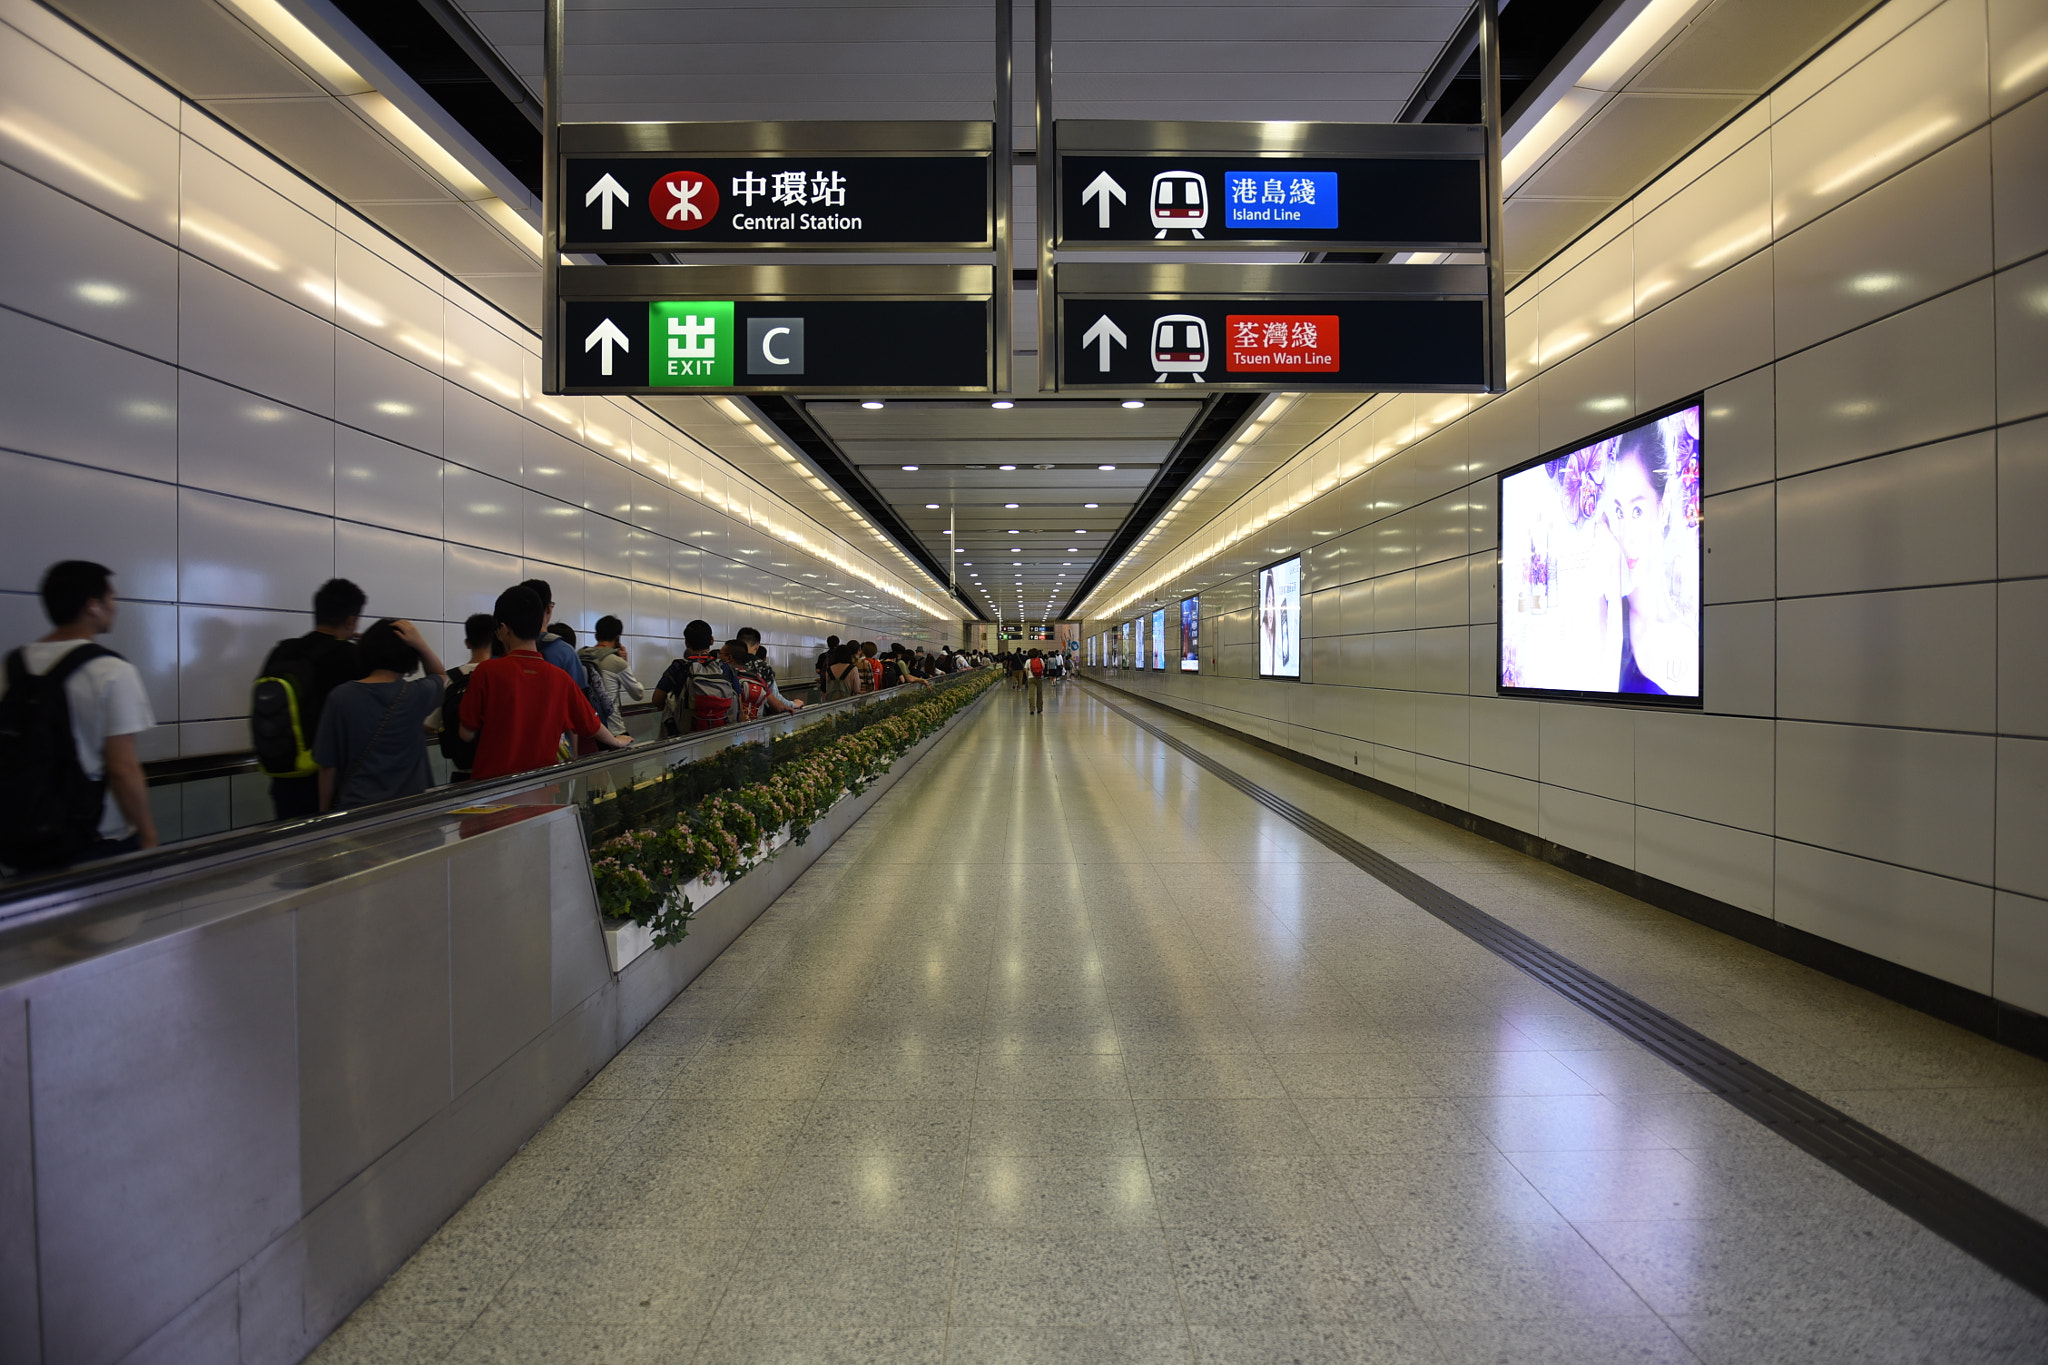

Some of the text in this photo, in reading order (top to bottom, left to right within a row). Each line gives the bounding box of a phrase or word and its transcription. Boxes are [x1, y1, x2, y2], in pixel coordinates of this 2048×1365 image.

[732, 170, 847, 207] 中環站
[1231, 178, 1316, 205] 港島綫
[732, 213, 862, 230] Central Station
[1233, 208, 1301, 221] Island Line
[667, 315, 716, 358] 出
[762, 327, 791, 365] C
[1233, 322, 1318, 349] 荃灣綫
[667, 360, 715, 375] EXIT
[1233, 352, 1332, 364] Tsuen Wan Line
